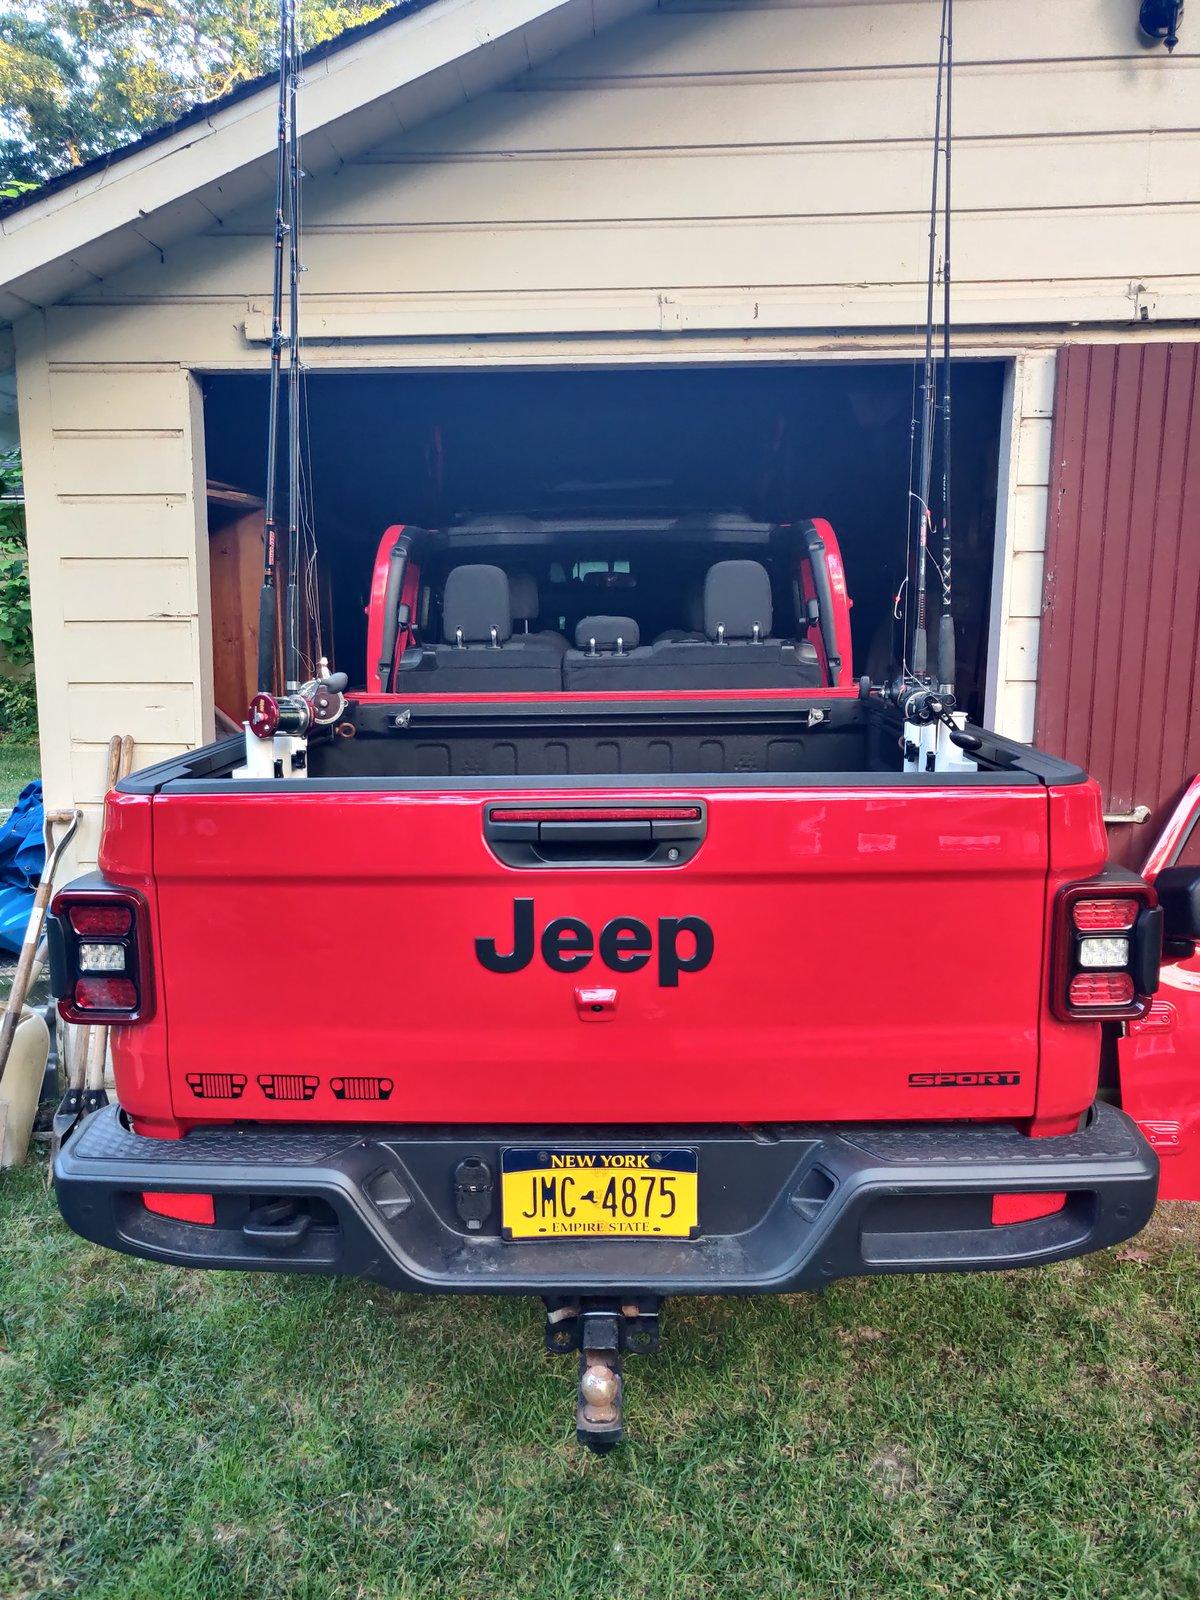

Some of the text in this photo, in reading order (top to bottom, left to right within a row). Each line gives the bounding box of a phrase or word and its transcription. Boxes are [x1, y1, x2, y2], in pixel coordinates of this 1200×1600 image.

[474, 897, 715, 988] Jeep
[909, 1071, 1020, 1087] SPORT
[551, 1154, 650, 1168] NEW YORK
[522, 1176, 677, 1218] JMC 4875
[552, 1222, 649, 1233] EMPIRE STATE
